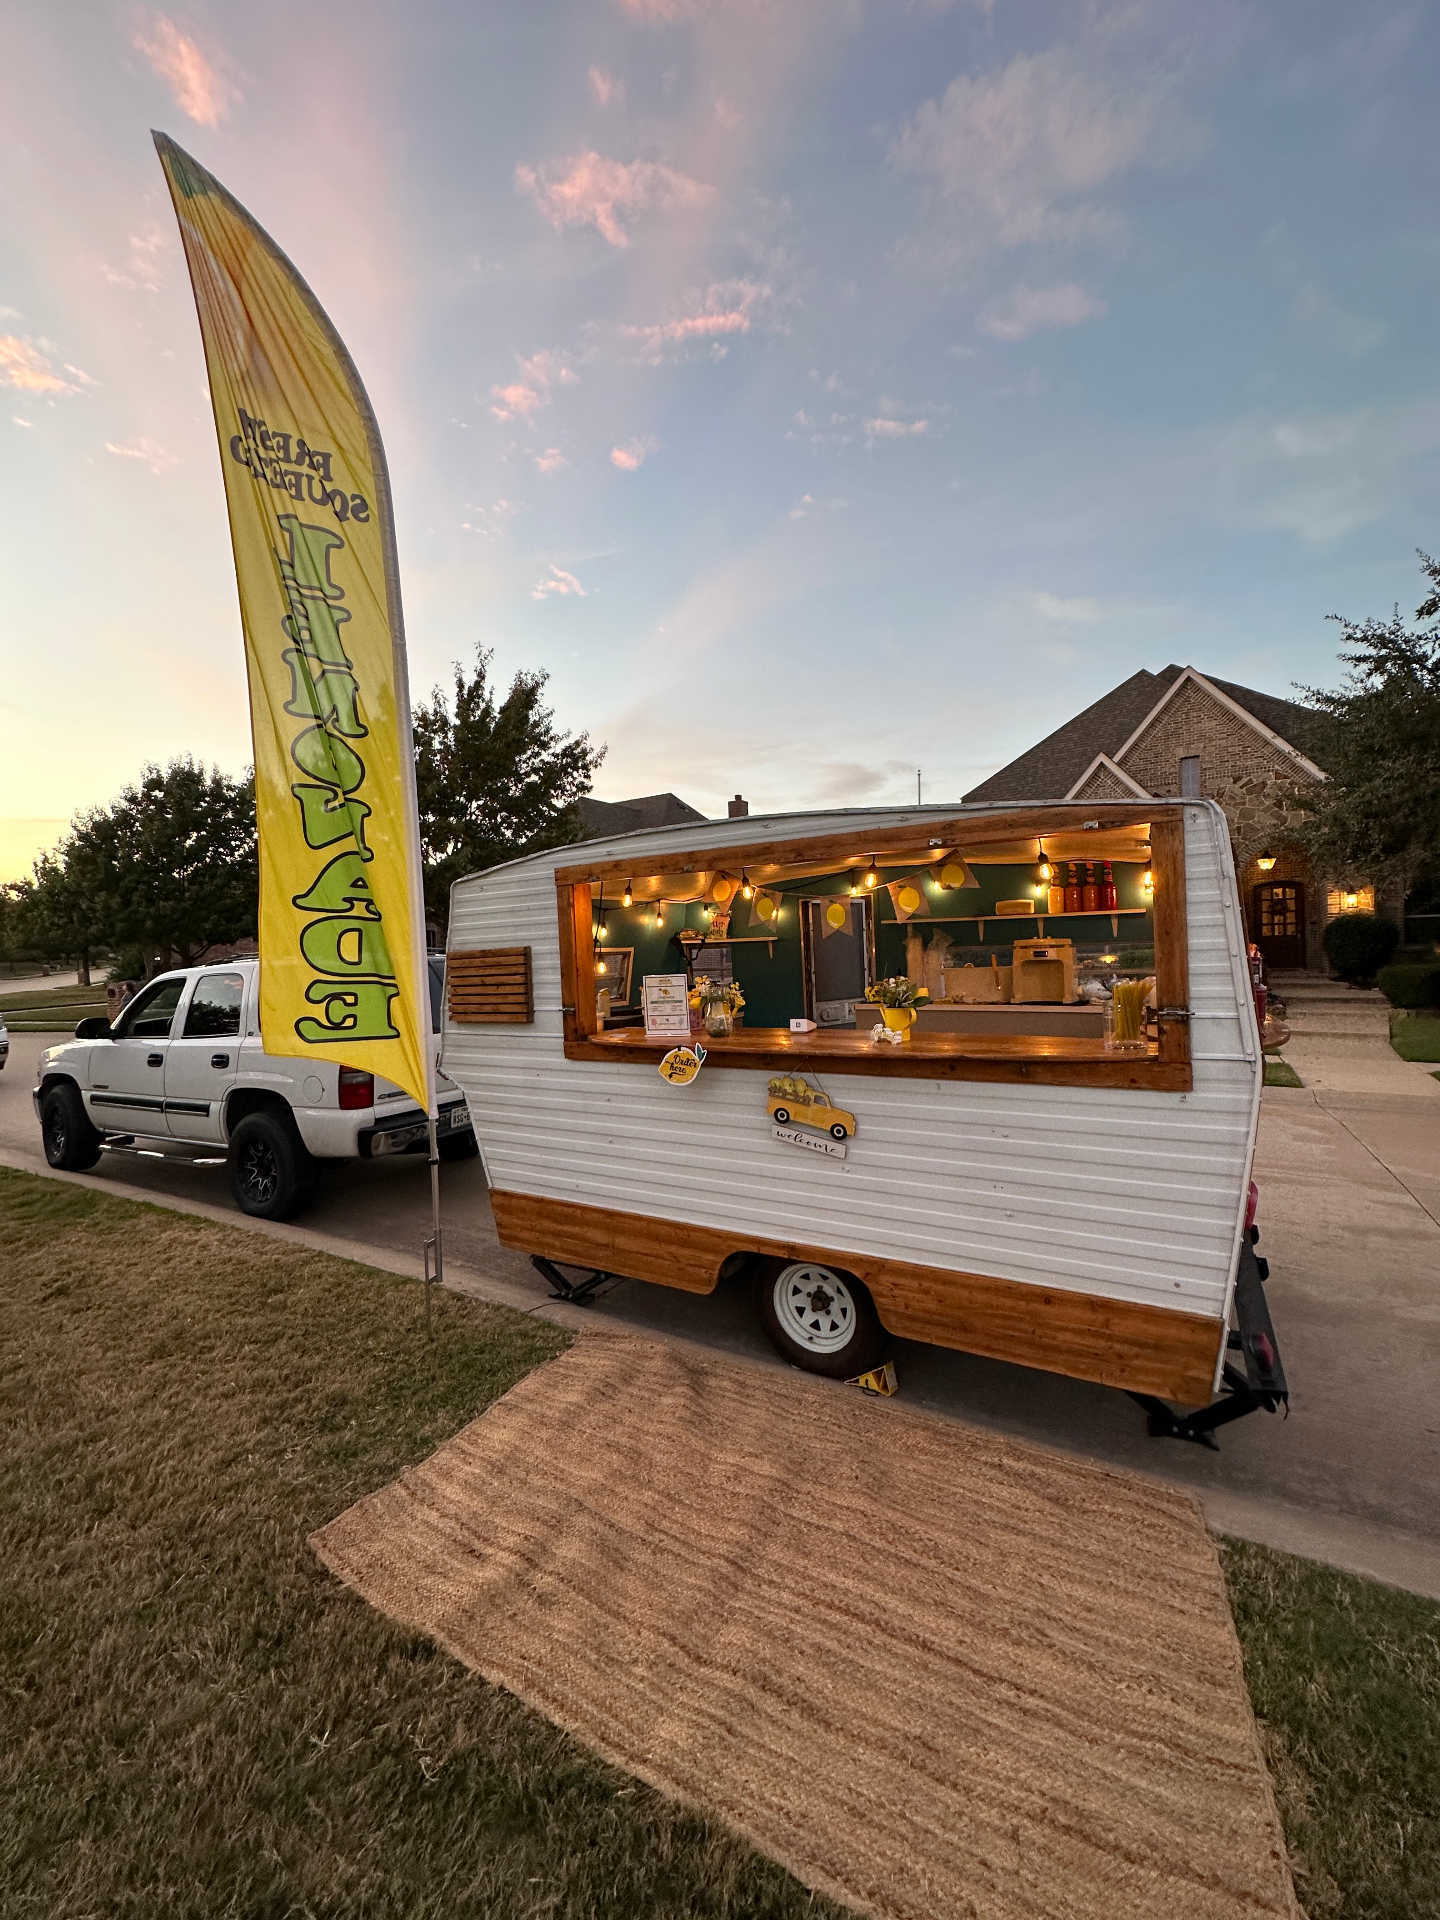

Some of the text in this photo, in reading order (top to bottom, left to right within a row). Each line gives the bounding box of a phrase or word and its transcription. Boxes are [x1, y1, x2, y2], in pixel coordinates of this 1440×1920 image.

[666, 1061, 686, 1074] here
[674, 1054, 697, 1068] Order
[776, 1130, 839, 1153] welcome
